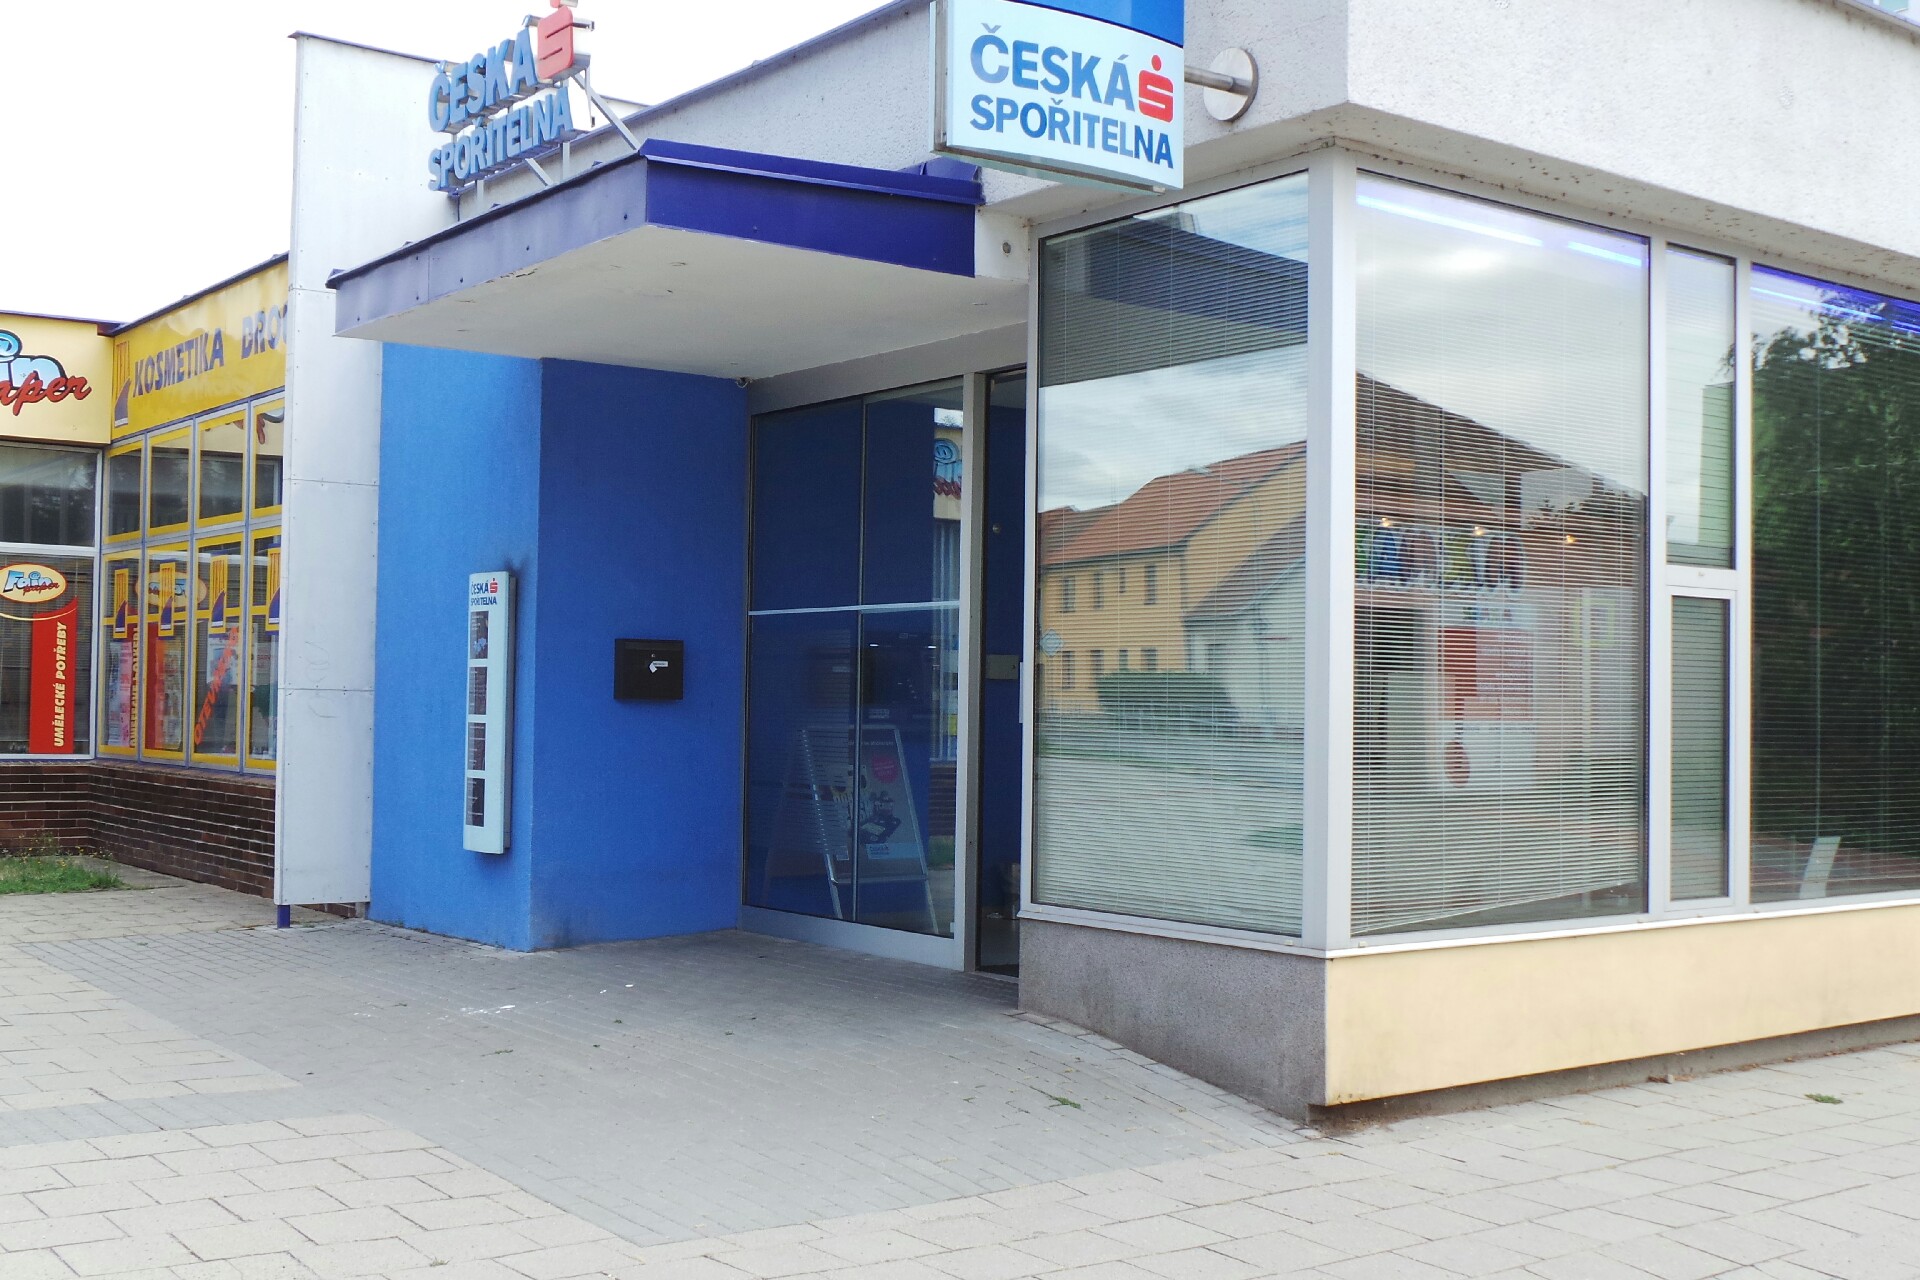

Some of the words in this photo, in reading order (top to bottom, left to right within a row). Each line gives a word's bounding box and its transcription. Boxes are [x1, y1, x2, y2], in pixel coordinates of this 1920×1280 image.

[428, 14, 538, 133] ČESKÁ
[970, 23, 1136, 112] ČESKÁ
[428, 86, 574, 191] SPOŘITELNA
[970, 94, 1174, 169] SPOŘITELNA
[133, 327, 225, 398] KOSMETIKA
[53, 621, 67, 680] POTŘEBY
[52, 682, 66, 747] UMĚLECKÉ
